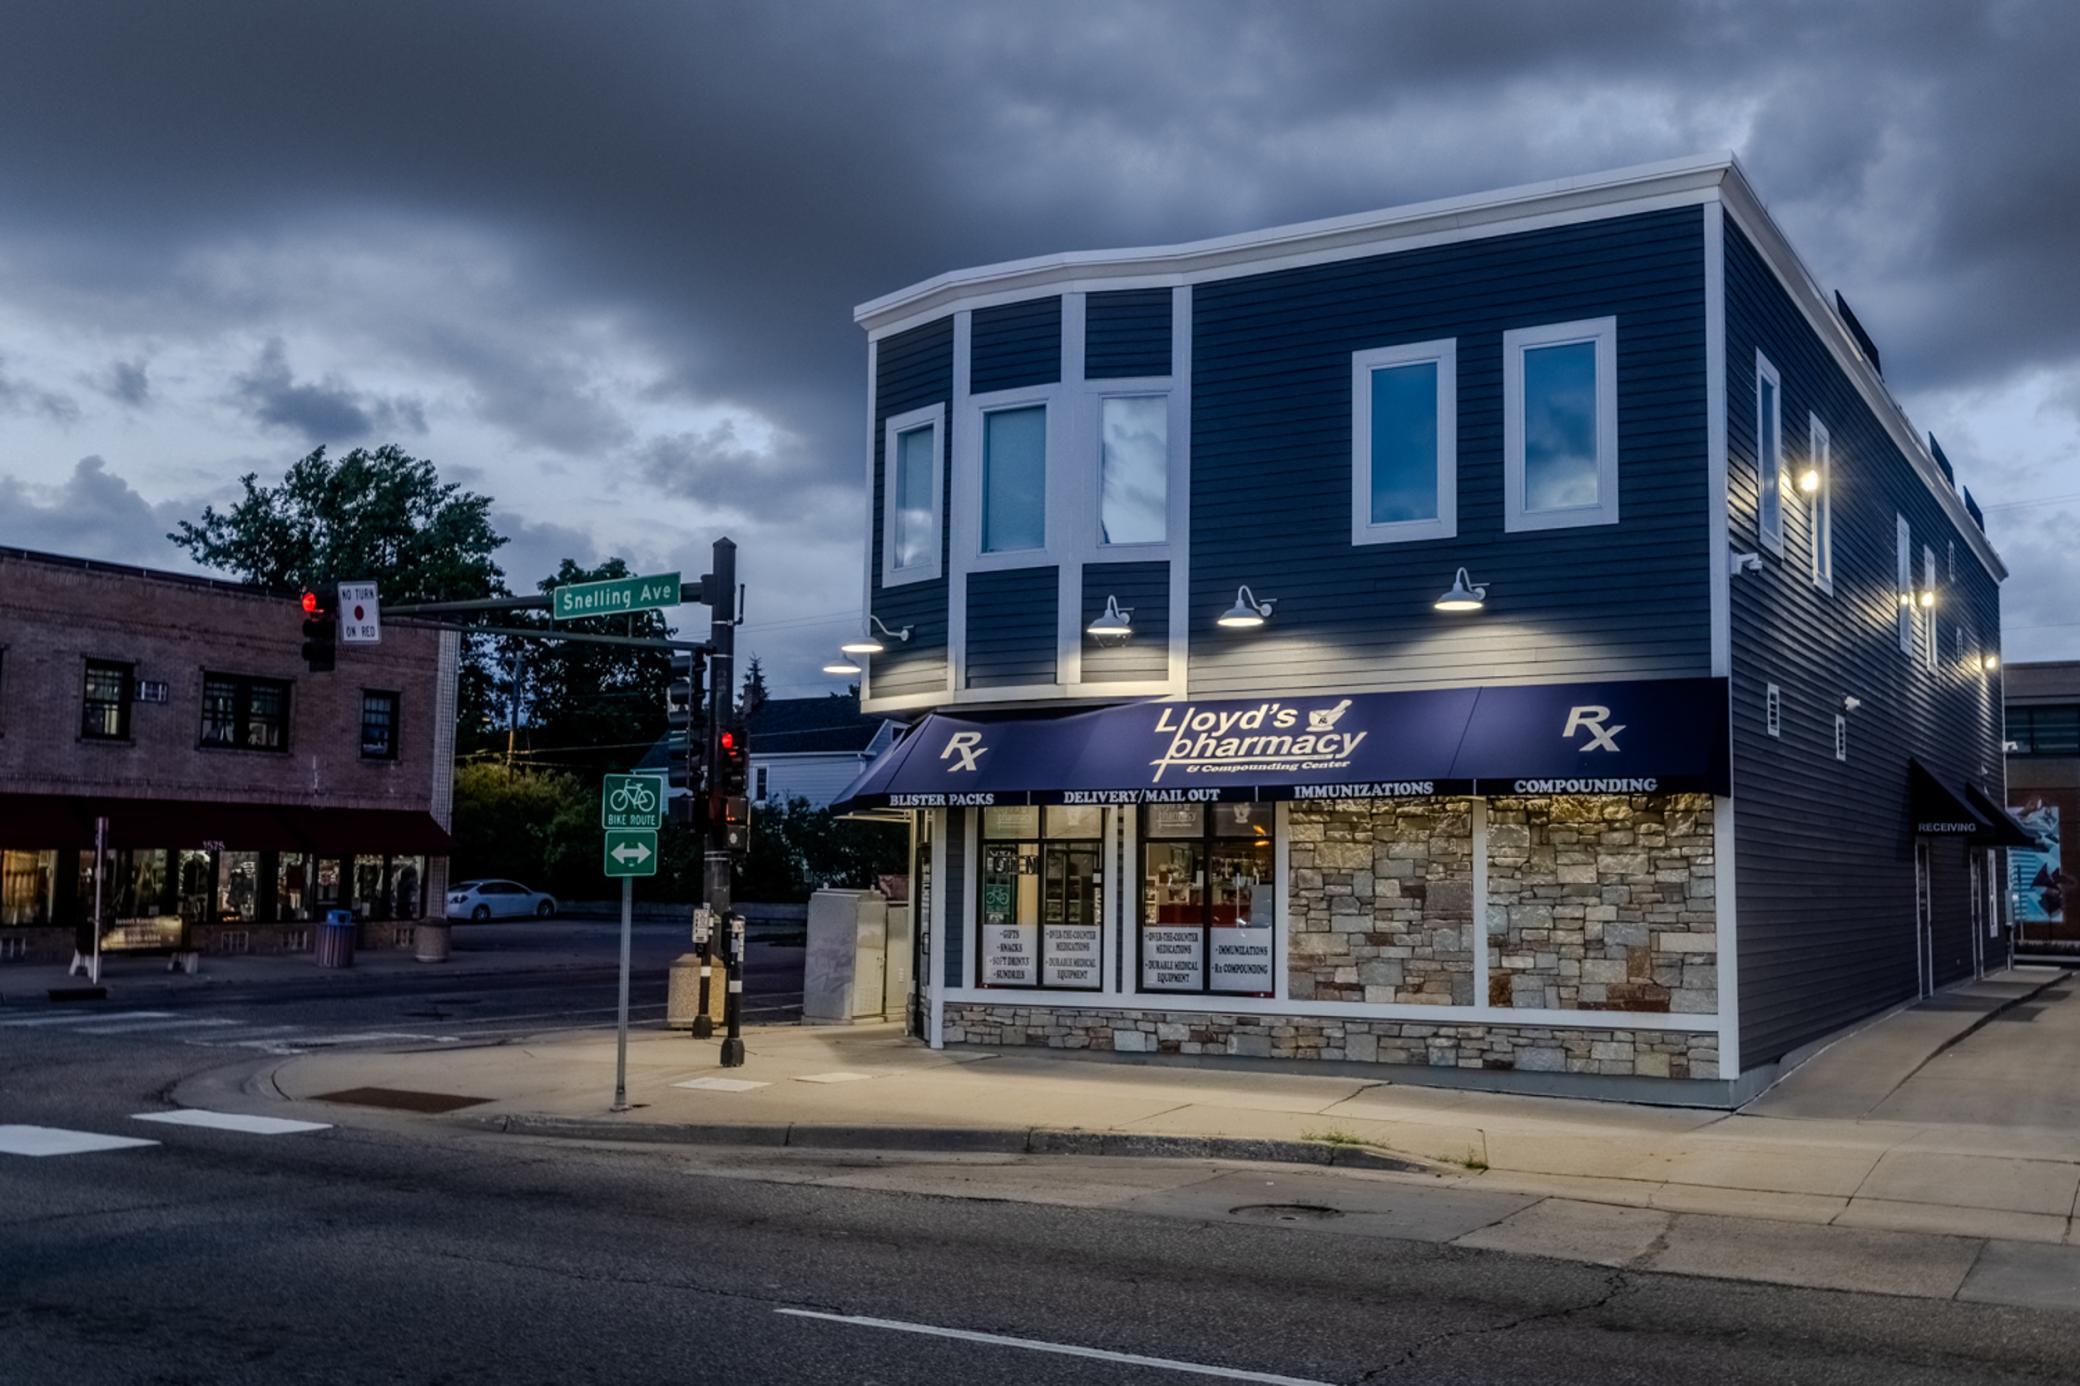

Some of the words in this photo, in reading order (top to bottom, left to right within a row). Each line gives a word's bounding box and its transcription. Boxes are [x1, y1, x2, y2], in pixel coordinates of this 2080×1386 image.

[342, 589, 351, 600] NO
[355, 588, 374, 600] TURN
[563, 588, 631, 611] Snelling
[640, 584, 671, 602] Ave
[346, 626, 356, 638] ON
[361, 625, 376, 638] RED
[1154, 703, 1298, 737] Lloyd's
[1562, 705, 1627, 752] Rx
[940, 731, 988, 772] Rx
[1154, 731, 1368, 777] pharmacy
[1186, 765, 1198, 773] &
[1201, 761, 1299, 773] Compounding
[1301, 760, 1351, 770] Center
[1294, 781, 1435, 799] IMMUNIZATIONS
[1514, 778, 1658, 793] COMPOUNDING
[889, 792, 946, 806] BLISTER
[949, 792, 994, 806] PACKS
[1064, 788, 1187, 804] DELIVERY/MAIL
[1191, 788, 1220, 802] OUT
[608, 814, 627, 825] BIKE
[630, 814, 656, 825] ROUTE
[1918, 823, 1976, 832] RECEIVING
